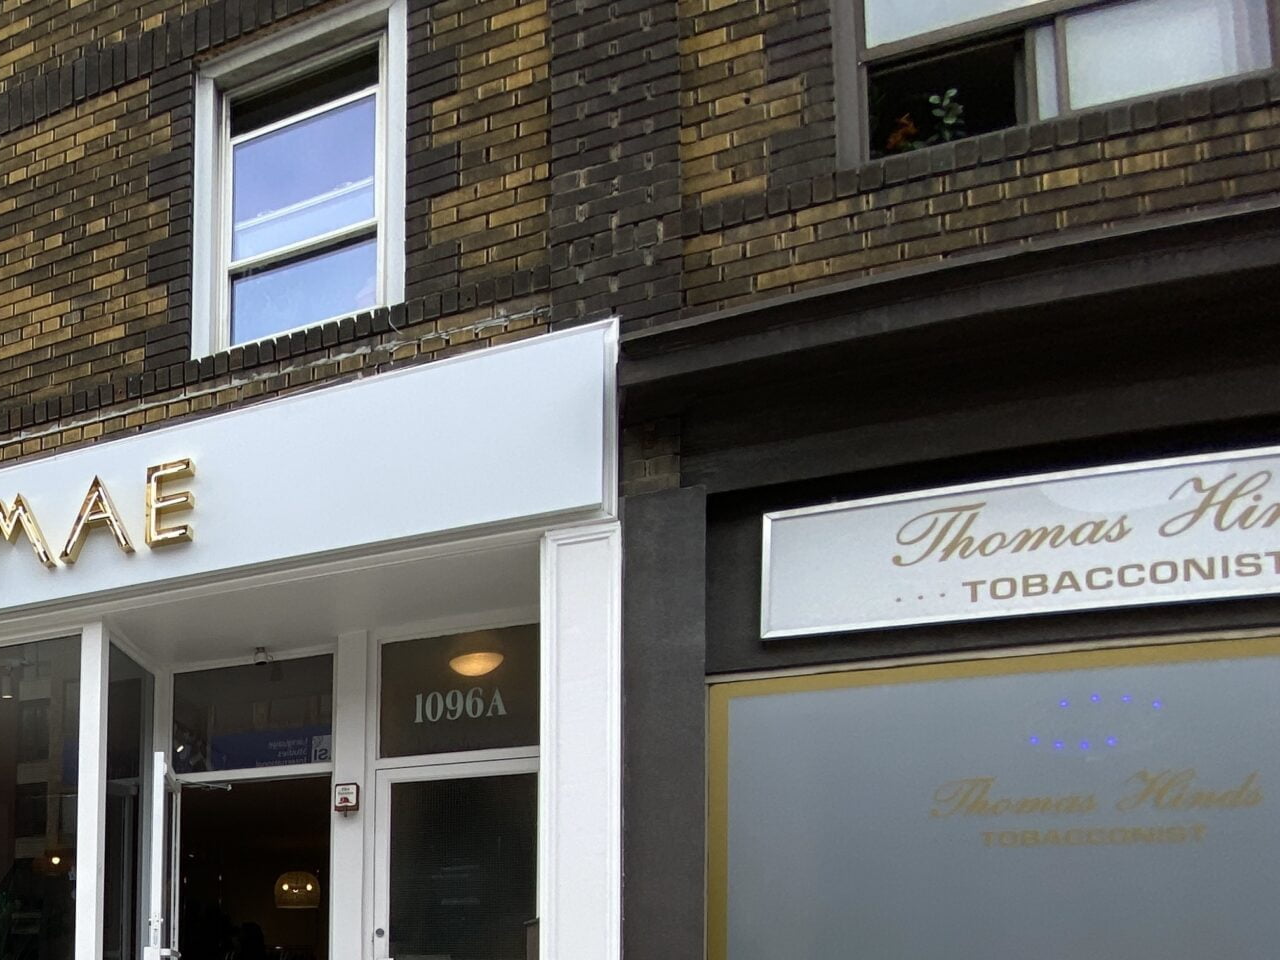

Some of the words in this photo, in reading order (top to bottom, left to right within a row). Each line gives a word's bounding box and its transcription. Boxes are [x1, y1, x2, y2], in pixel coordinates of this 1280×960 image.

[891, 501, 1132, 567] Thomas
[414, 687, 507, 723] 1096A
[928, 775, 1098, 819] Thomas
[1114, 767, 1265, 813] Hinds
[981, 823, 1208, 848] TOBACCONIST
